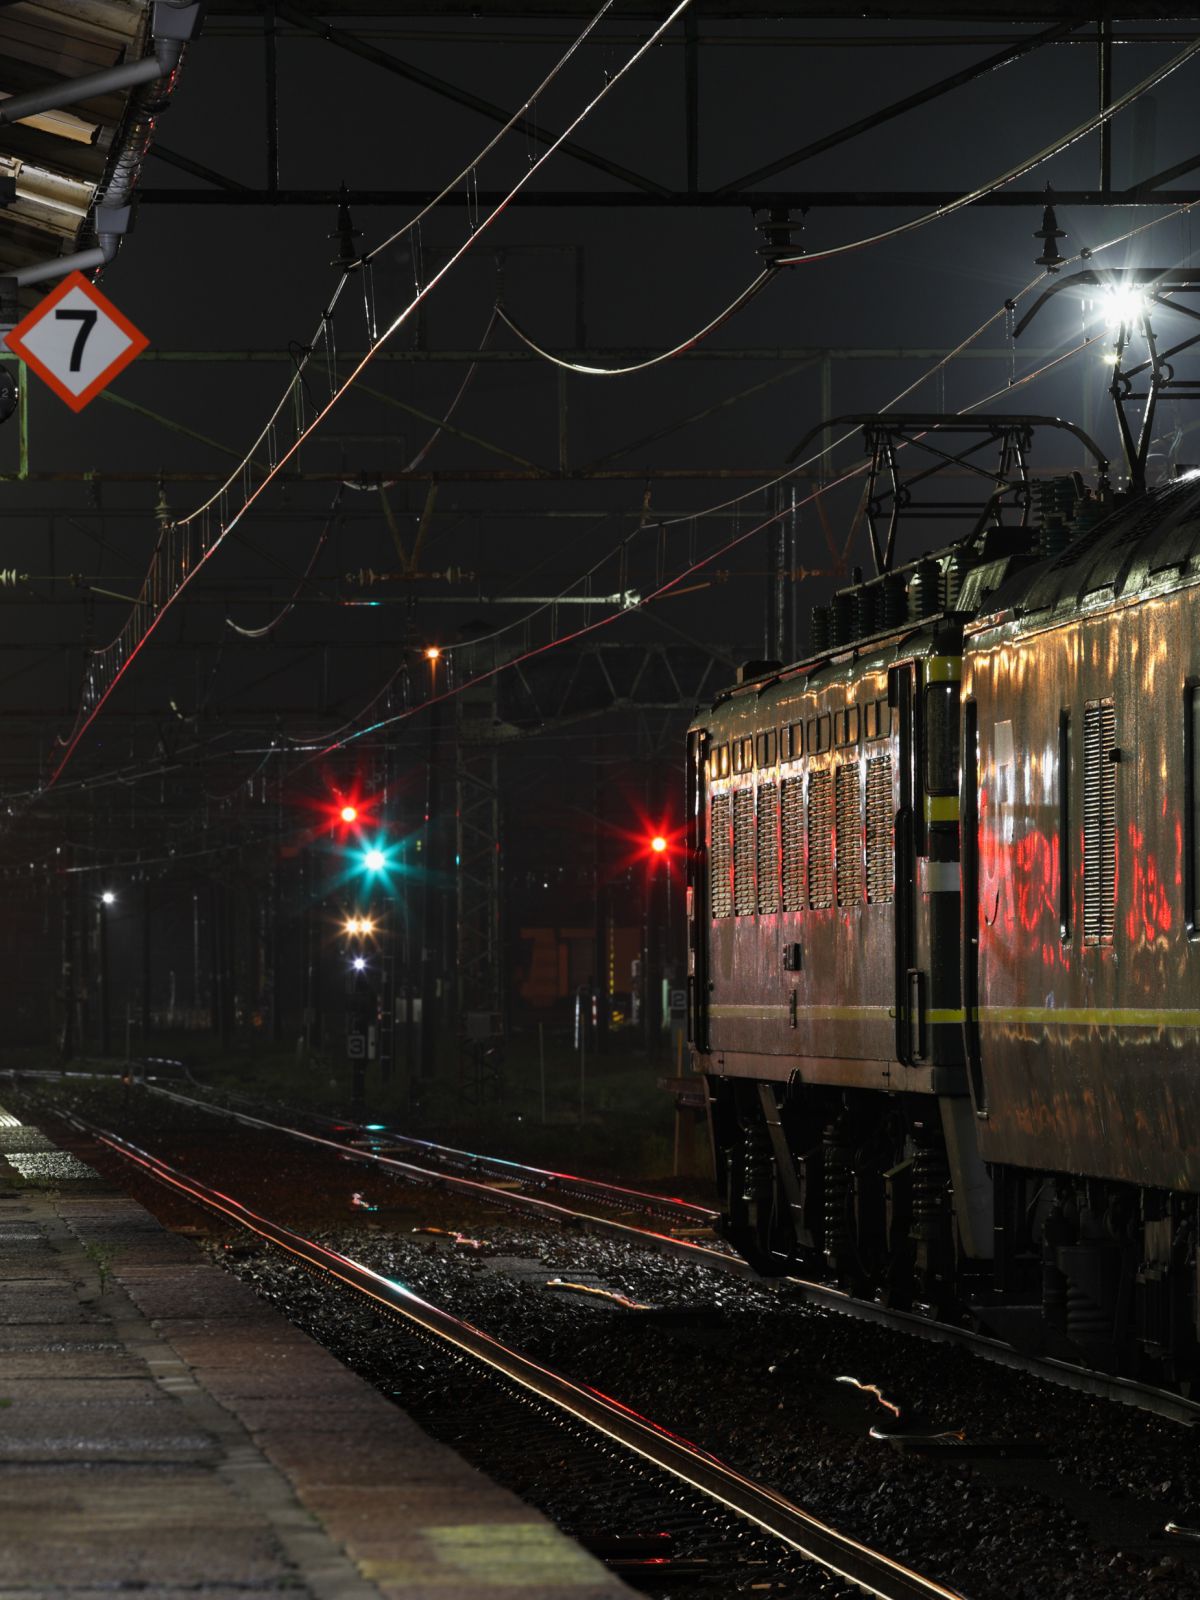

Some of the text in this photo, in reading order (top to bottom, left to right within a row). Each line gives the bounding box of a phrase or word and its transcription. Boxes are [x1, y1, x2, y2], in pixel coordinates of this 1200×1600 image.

[55, 310, 98, 372] 7
[673, 992, 686, 1008] 2
[350, 1037, 363, 1056] 3
